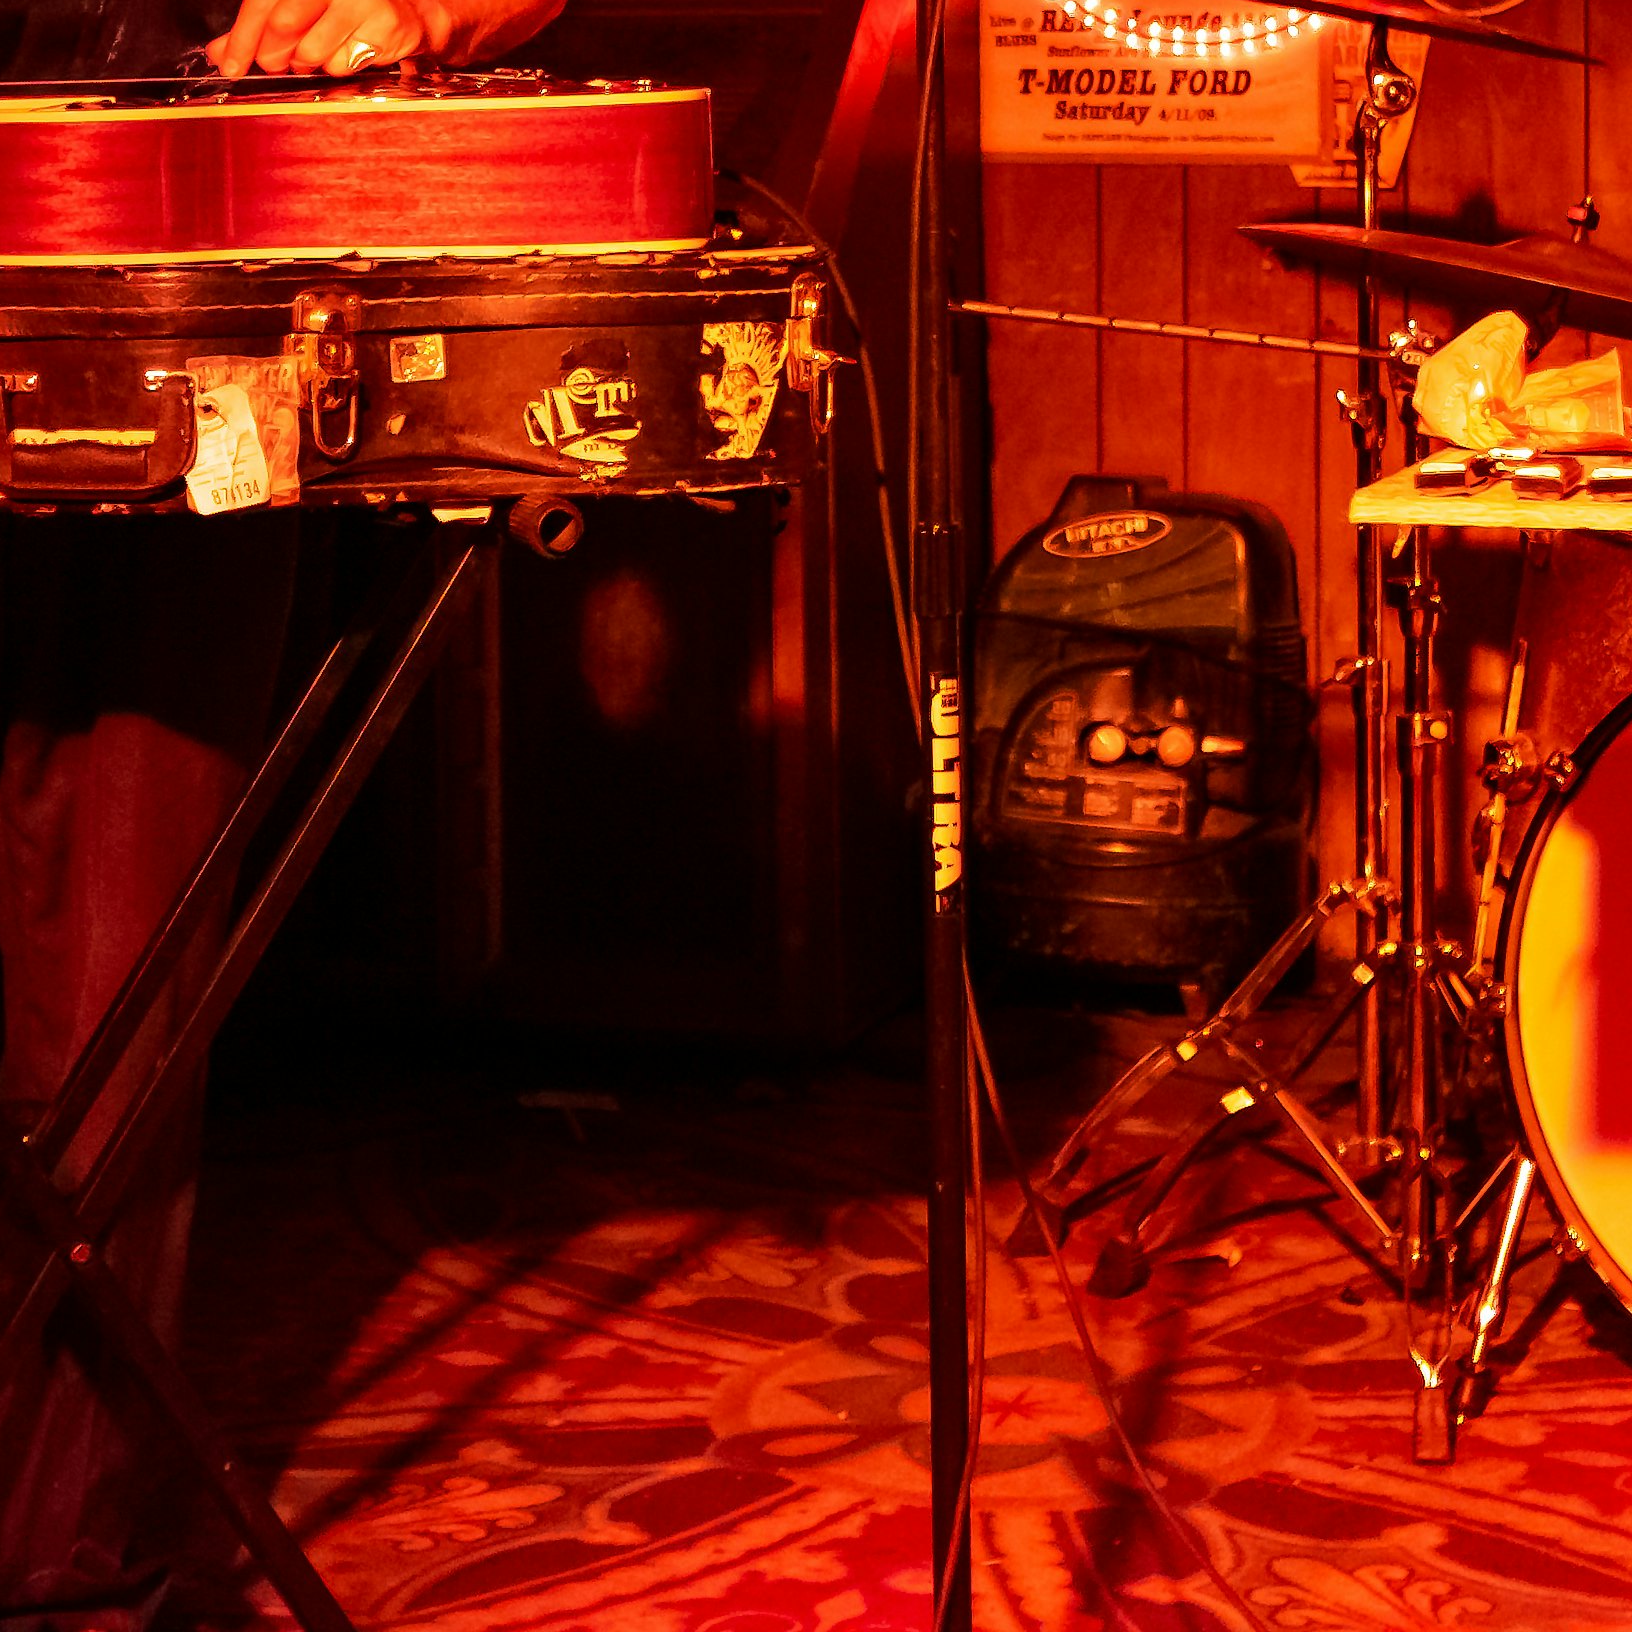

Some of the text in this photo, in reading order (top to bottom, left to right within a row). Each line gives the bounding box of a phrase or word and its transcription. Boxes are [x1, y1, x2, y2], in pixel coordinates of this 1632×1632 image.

[1018, 68, 1252, 97] T-MODEL FORD
[1054, 100, 1152, 127] Saturday
[930, 678, 963, 892] ULTRA
